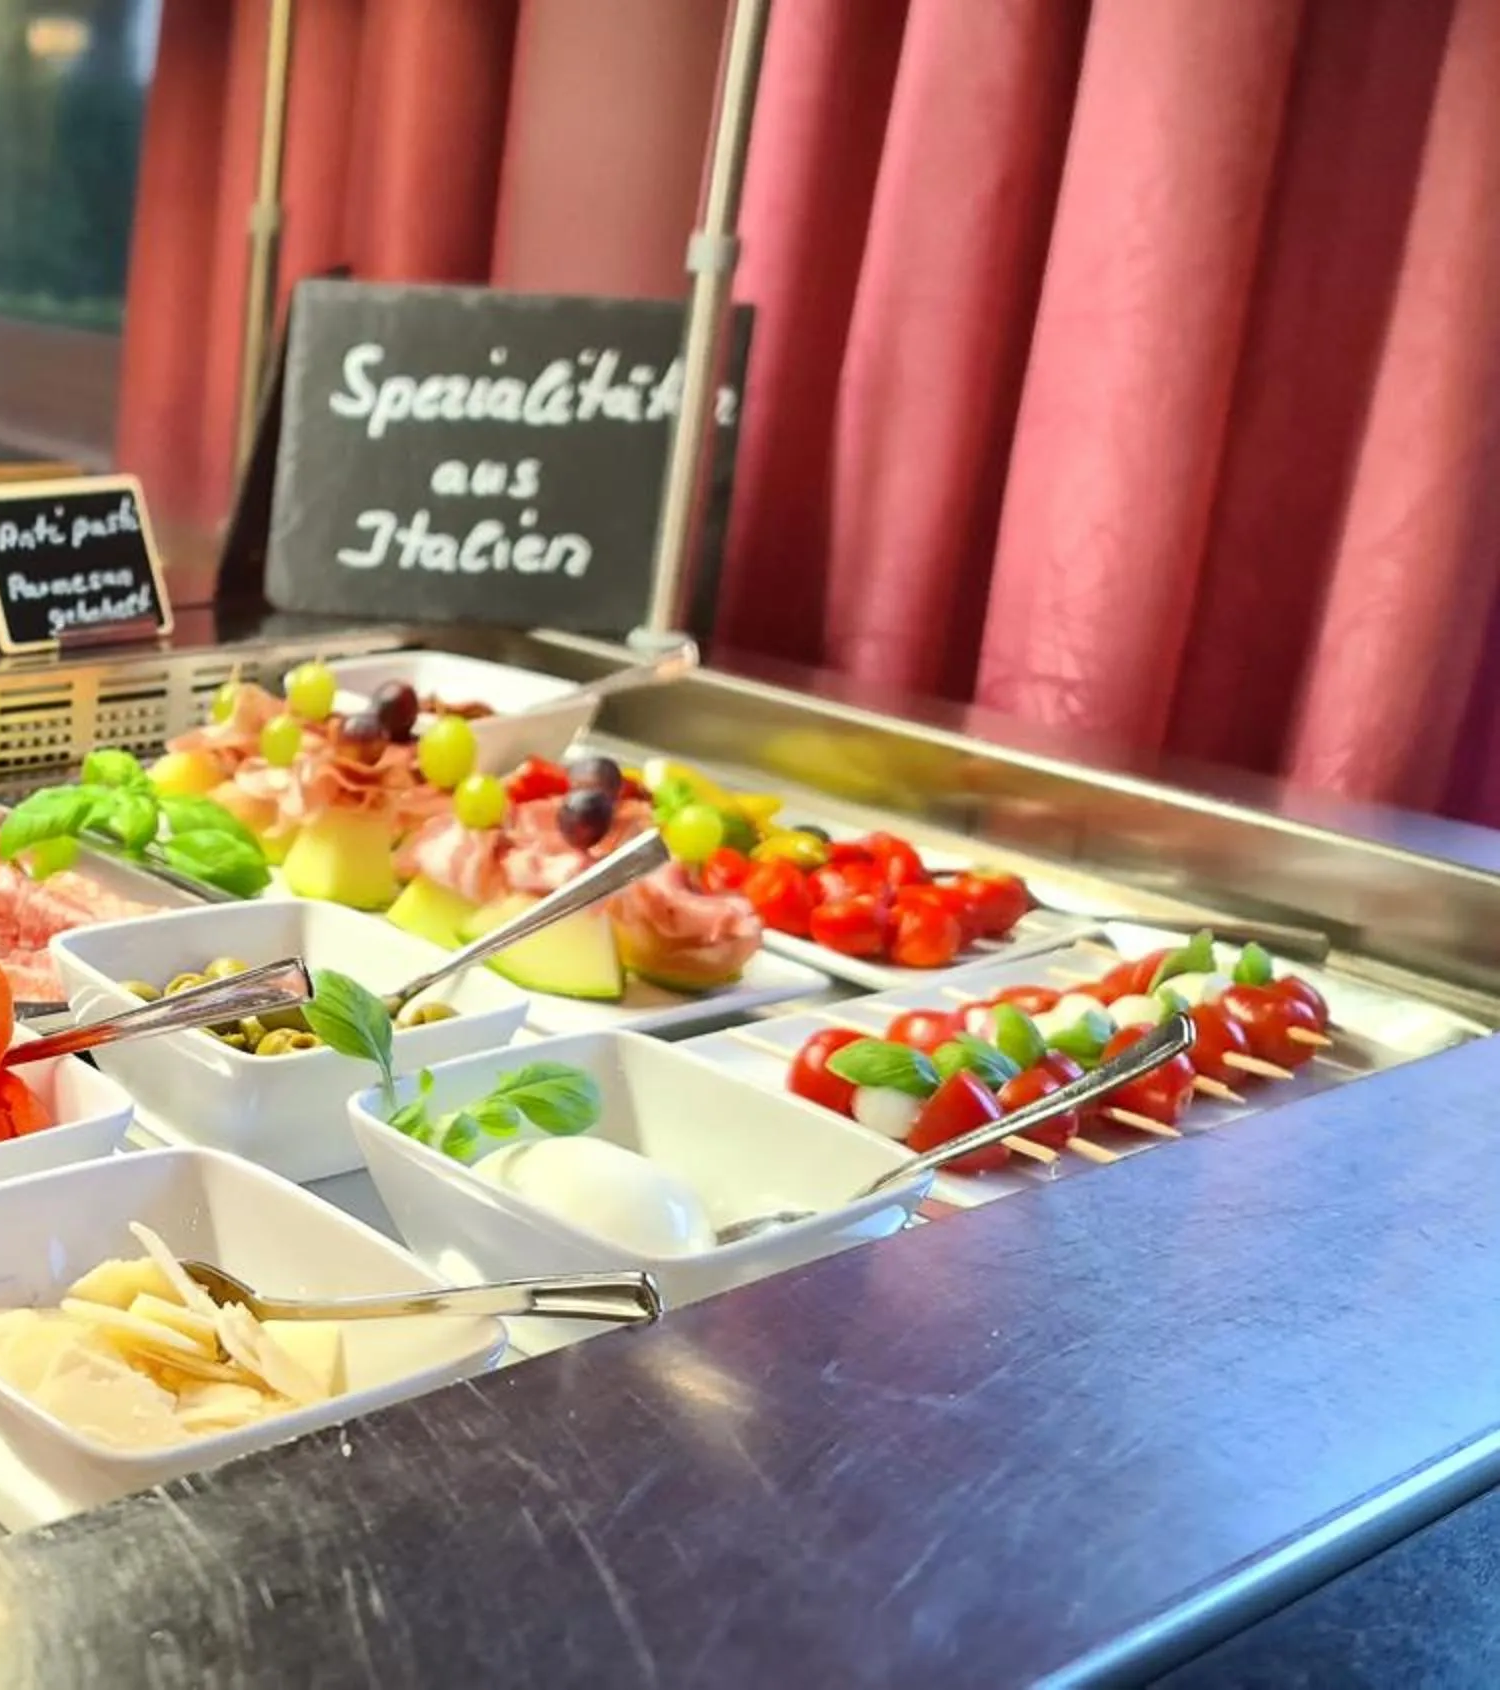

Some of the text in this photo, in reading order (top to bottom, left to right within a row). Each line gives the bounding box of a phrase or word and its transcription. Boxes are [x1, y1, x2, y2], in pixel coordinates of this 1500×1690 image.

[329, 343, 739, 439] Spezialität
[431, 458, 542, 499] aus
[336, 507, 593, 577] Italien
